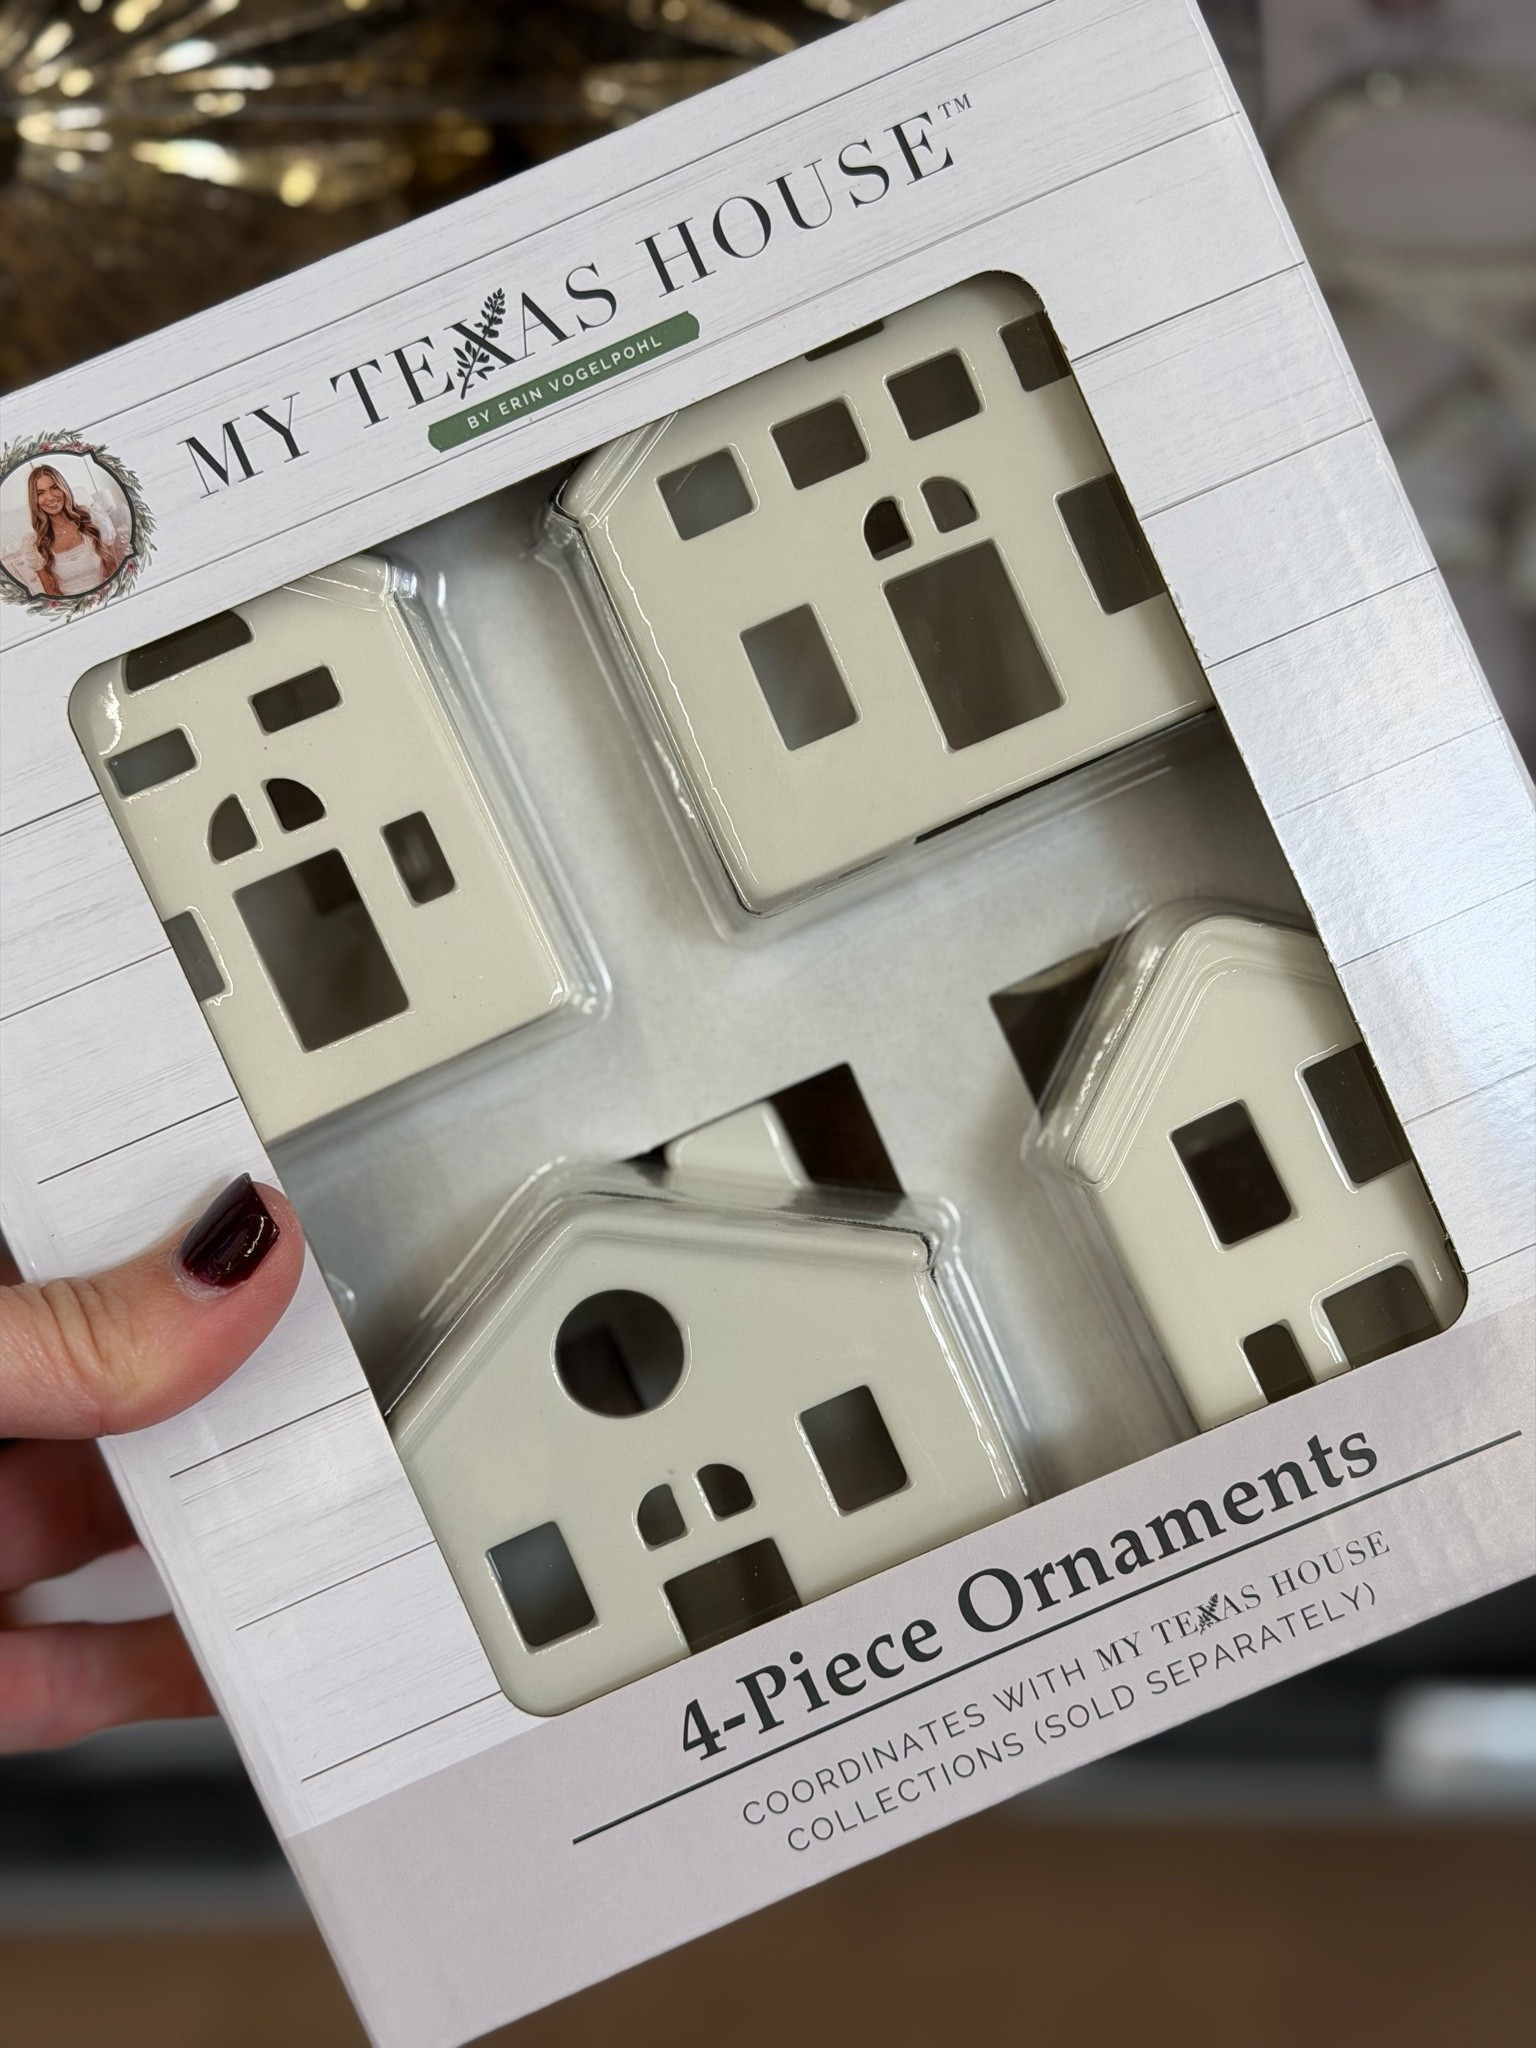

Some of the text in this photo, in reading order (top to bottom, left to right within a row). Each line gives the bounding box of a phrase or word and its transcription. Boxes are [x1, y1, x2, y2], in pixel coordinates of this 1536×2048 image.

[177, 393, 311, 498] MY
[330, 262, 618, 430] TEXAS
[466, 335, 662, 430] BY ERIN VOGELPOHL
[682, 1432, 1378, 1761] 4-Piece Ornaments
[742, 1529, 1390, 1826] COORDINATES WITH MY TEXAS HOUSE
[787, 1581, 1377, 1853] COLLECTIONS (SOLD SEPARATELY)
